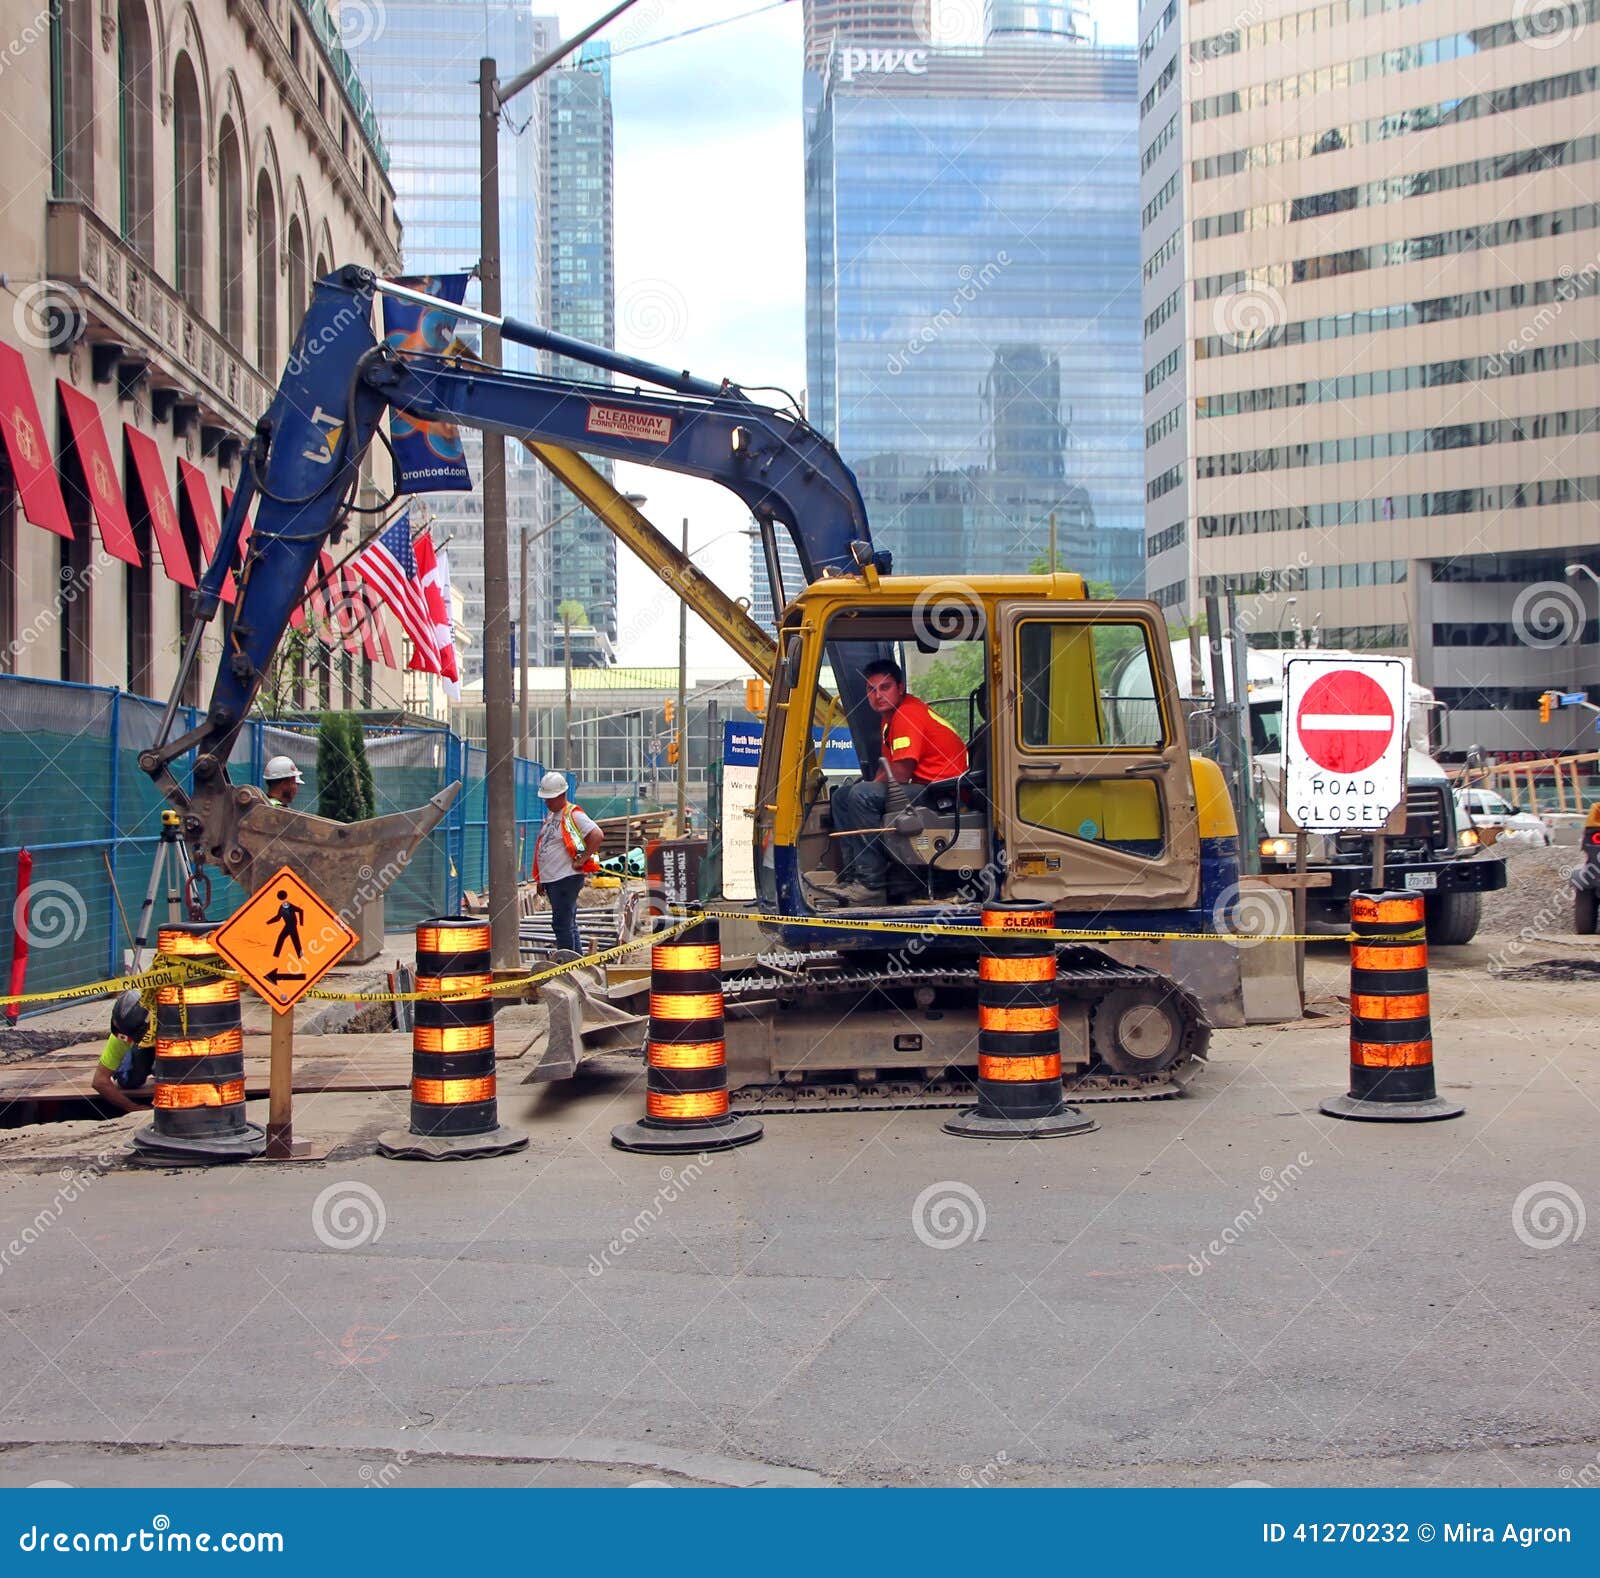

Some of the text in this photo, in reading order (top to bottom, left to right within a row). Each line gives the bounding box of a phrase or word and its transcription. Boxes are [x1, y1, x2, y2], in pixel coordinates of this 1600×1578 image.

[840, 45, 928, 82] pwc
[591, 419, 651, 433] CONSTRUCTION
[597, 410, 663, 428] CLEARWAY
[832, 740, 853, 750] Project
[1313, 780, 1375, 795] ROAD
[1297, 806, 1391, 821] CLOSED
[122, 971, 174, 993] CAUTION
